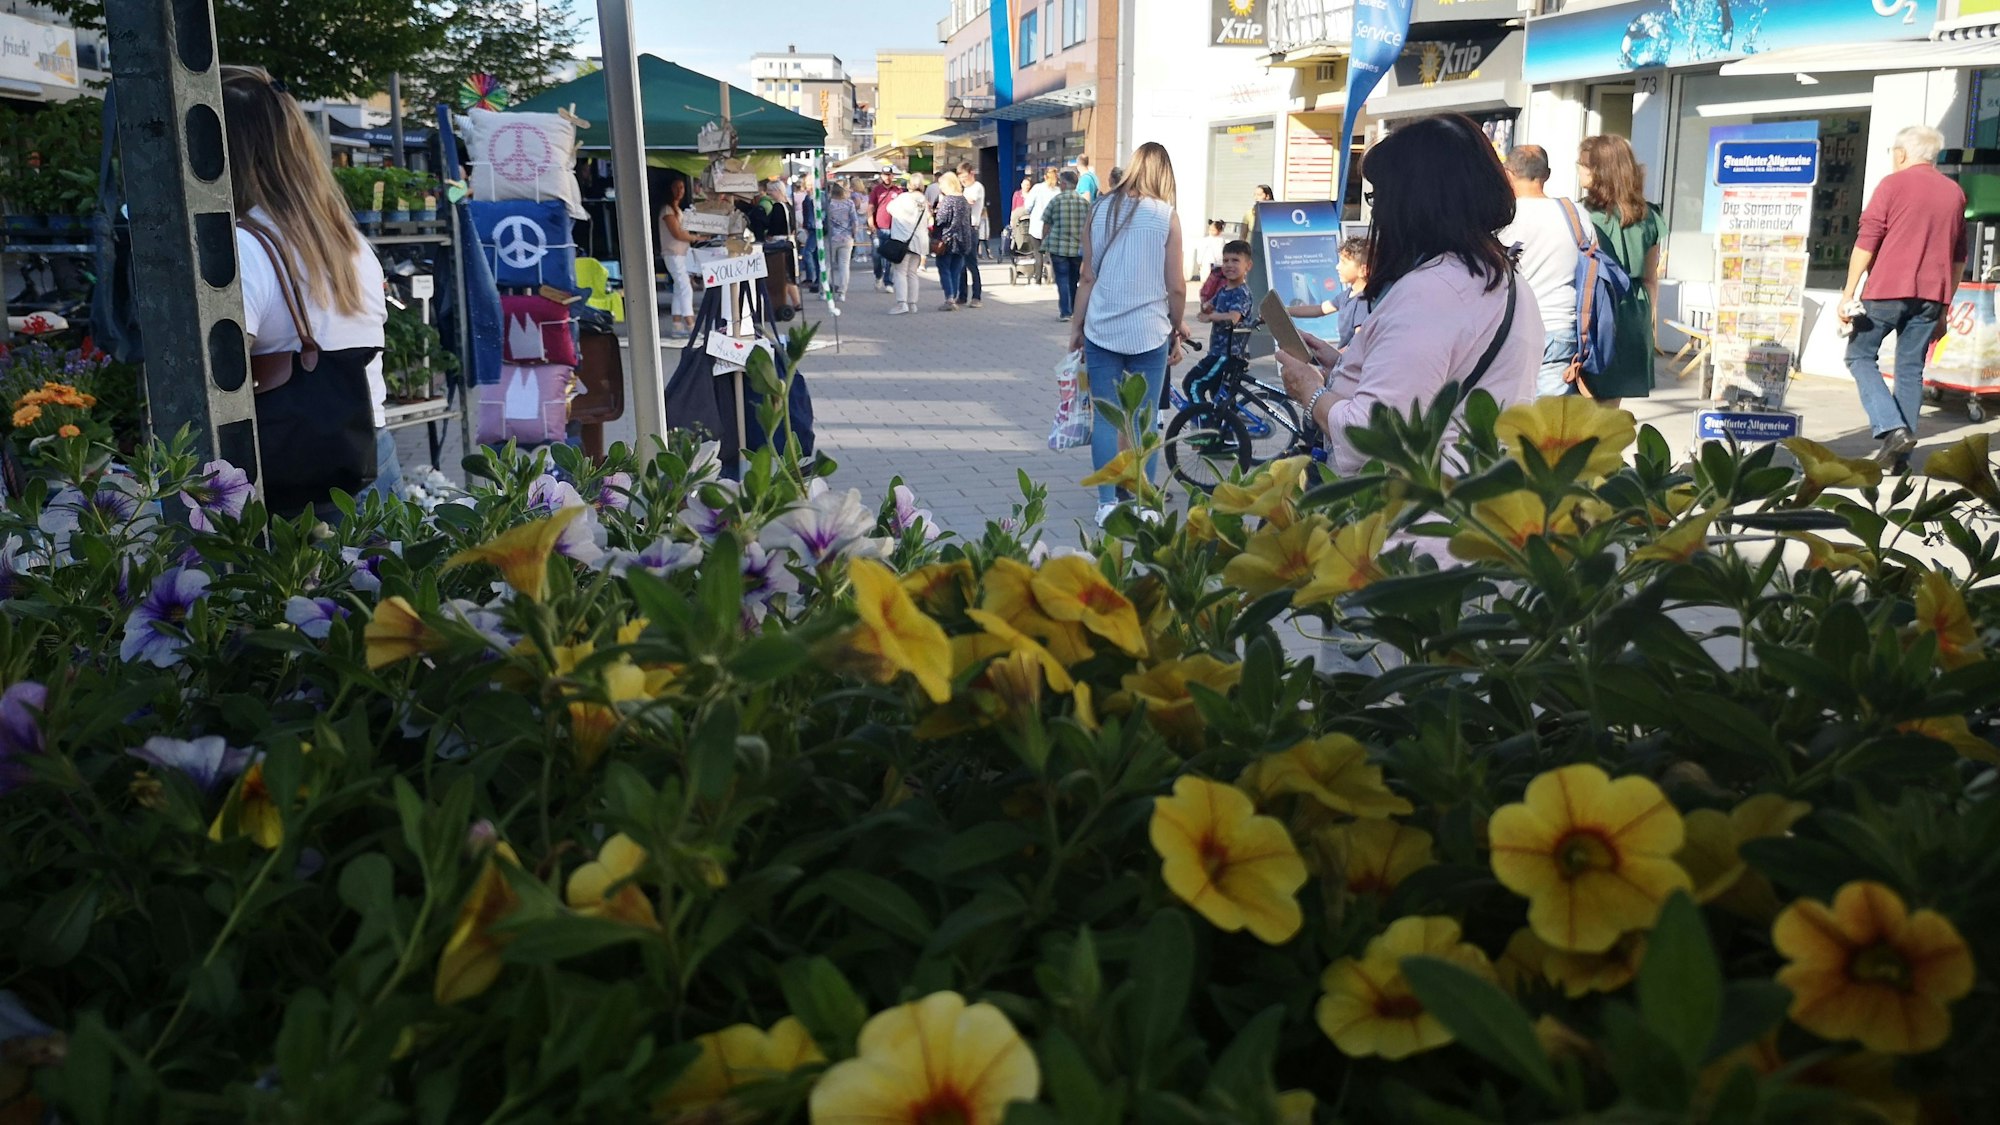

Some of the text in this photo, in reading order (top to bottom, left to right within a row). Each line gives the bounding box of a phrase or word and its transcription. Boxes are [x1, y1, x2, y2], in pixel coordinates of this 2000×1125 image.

[1355, 20, 1402, 47] Service
[1641, 76, 1657, 95] 73
[820, 89, 829, 127] HOTE
[1724, 154, 1812, 168] Frankfurter Allgemeine
[1723, 202, 1804, 216] Die Sorgen der
[711, 257, 763, 282] YOU & ME
[1747, 418, 1790, 431] Allgemeine
